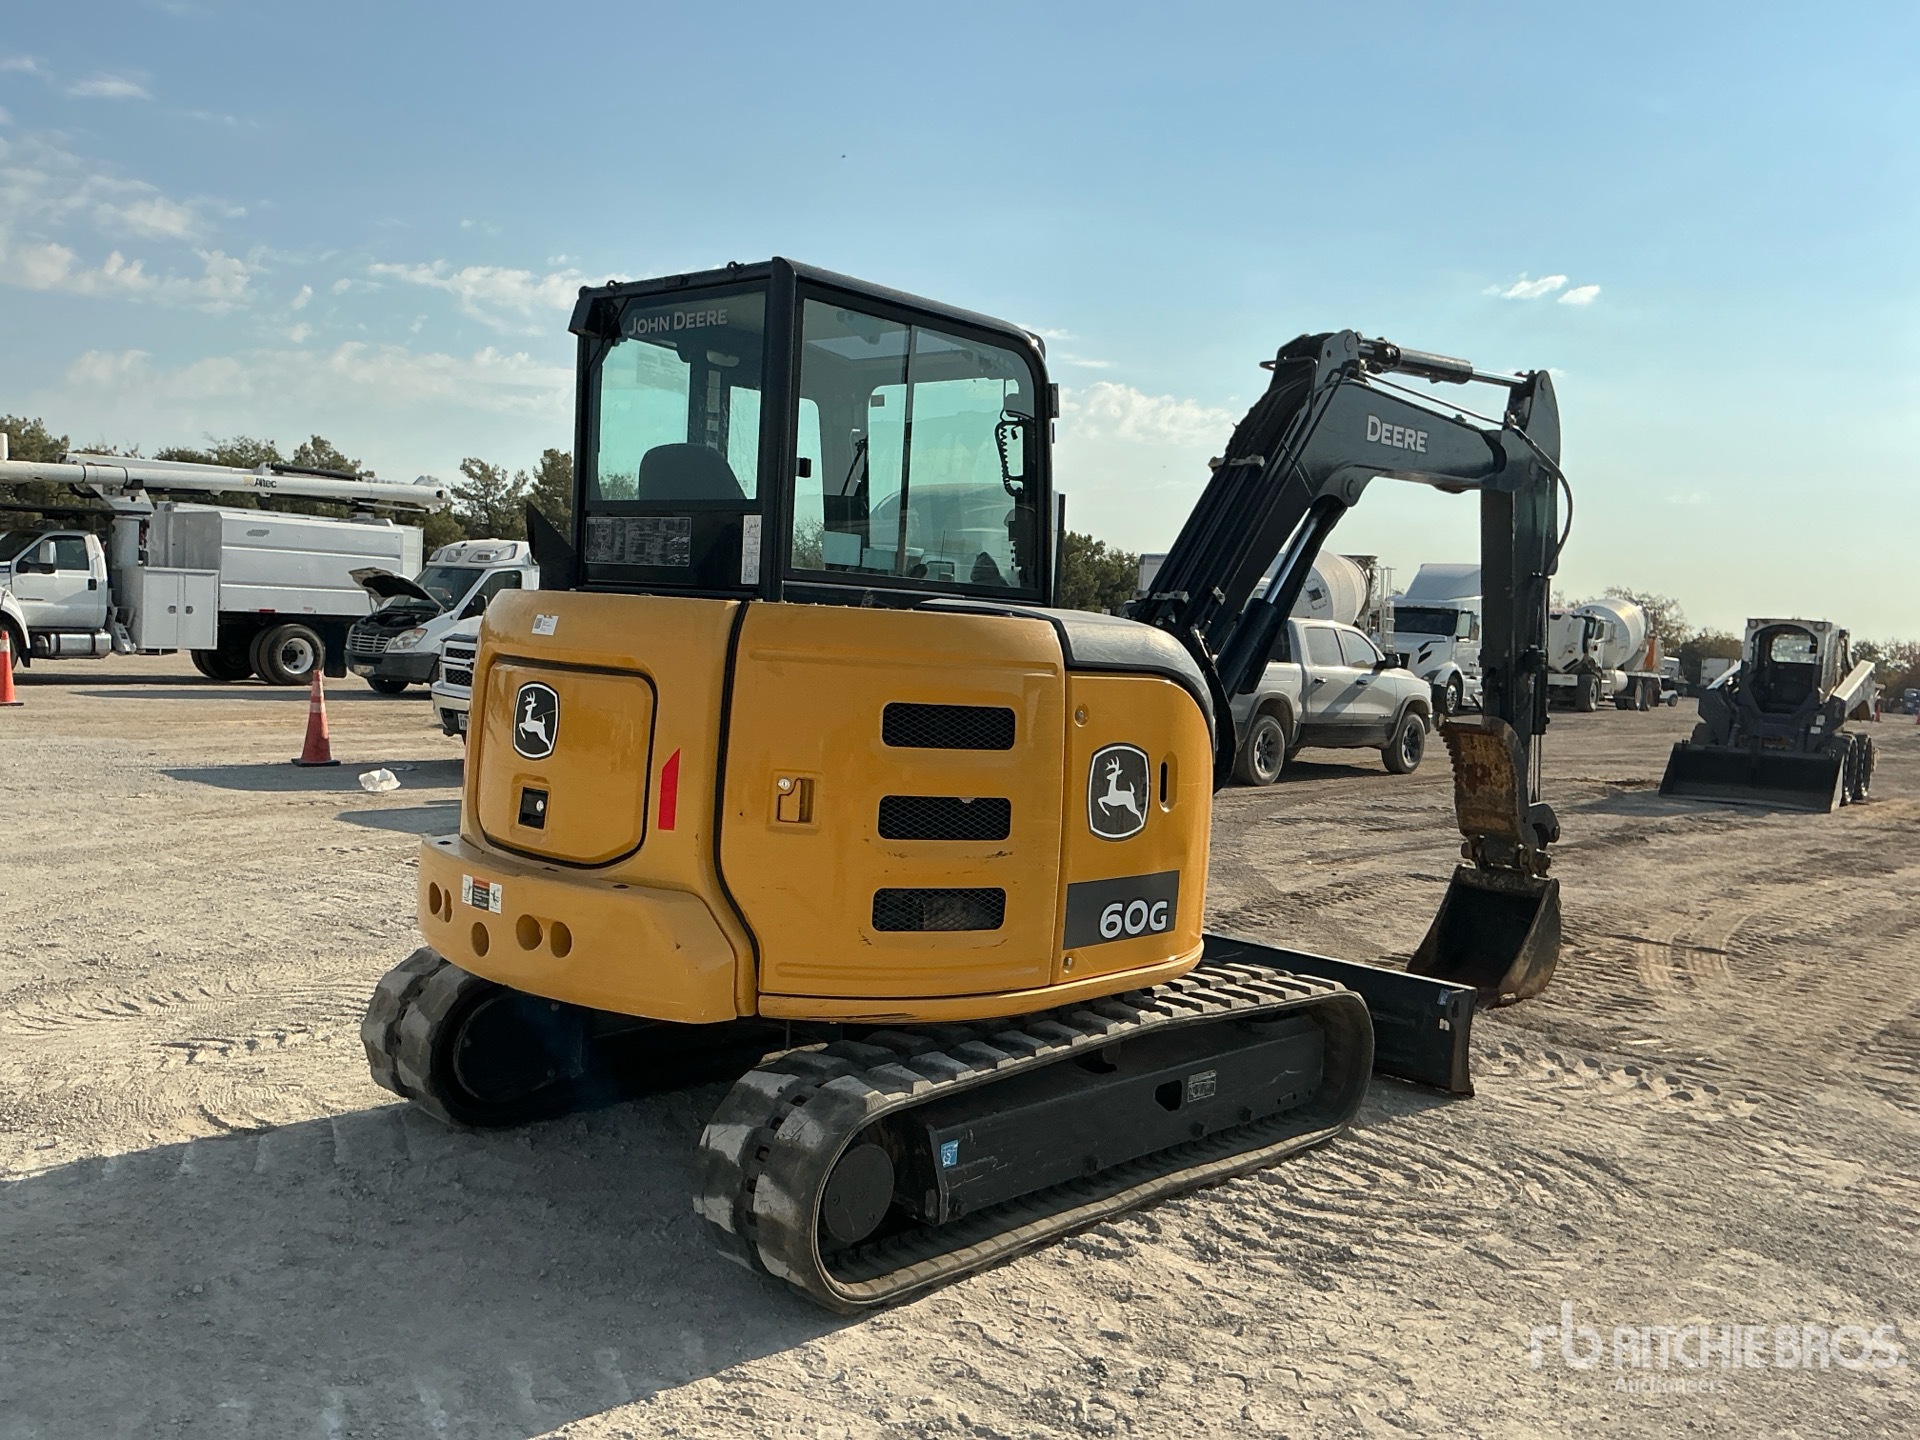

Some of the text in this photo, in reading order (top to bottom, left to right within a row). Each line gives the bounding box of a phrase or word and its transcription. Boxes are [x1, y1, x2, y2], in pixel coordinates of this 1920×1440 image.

[628, 309, 728, 335] JOHN DEERE
[1366, 414, 1428, 453] DEERE
[254, 477, 277, 488] Altec
[1100, 900, 1168, 939] 60G
